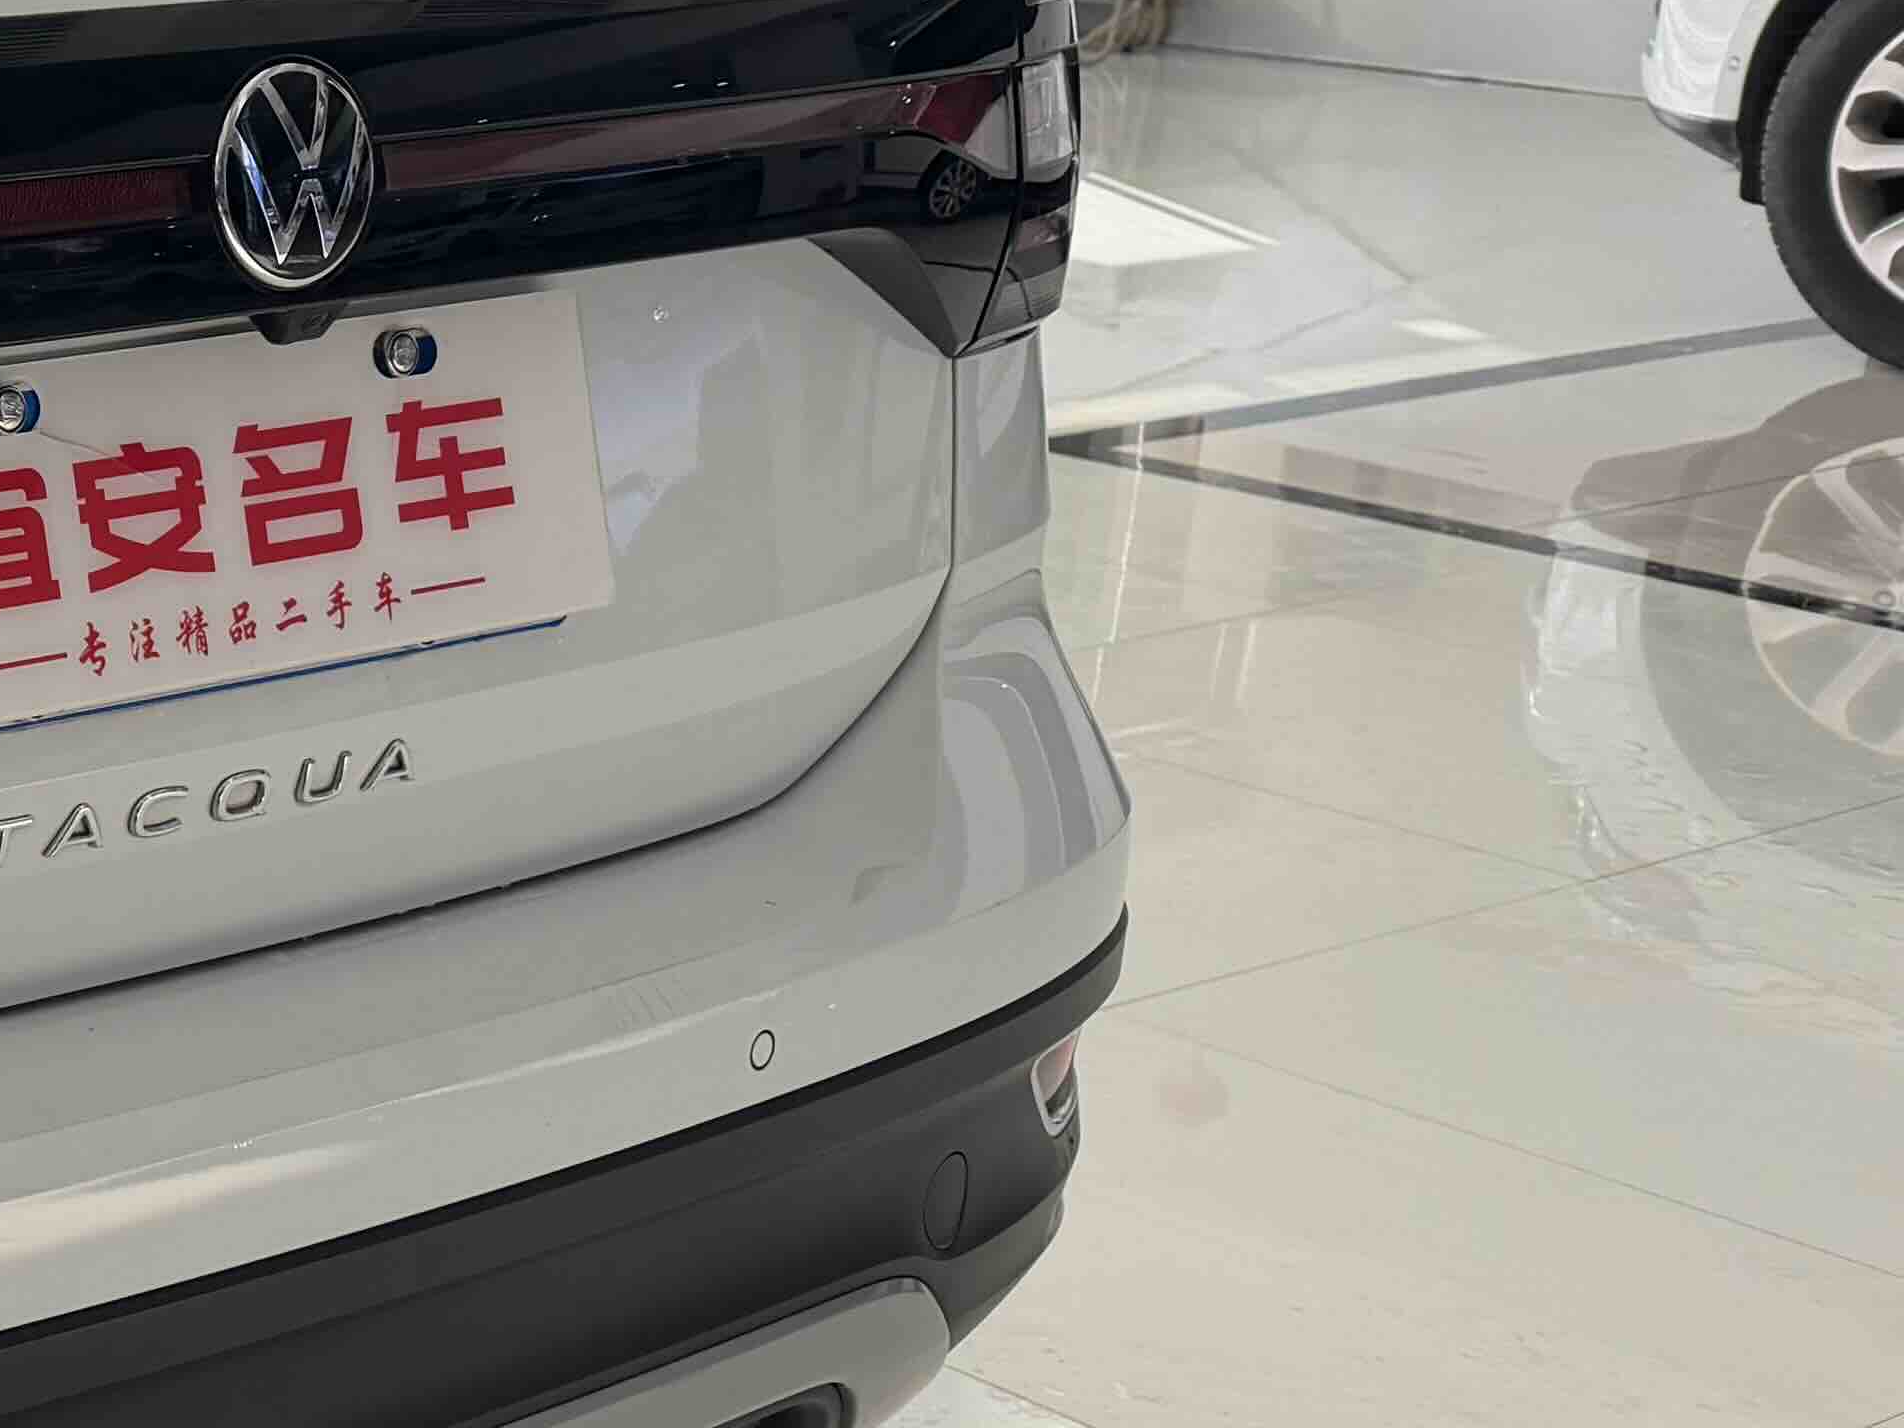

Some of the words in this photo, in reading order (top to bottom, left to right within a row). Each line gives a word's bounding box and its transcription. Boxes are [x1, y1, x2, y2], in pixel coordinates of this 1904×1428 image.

[78, 572, 403, 677] 专注精品二手车
